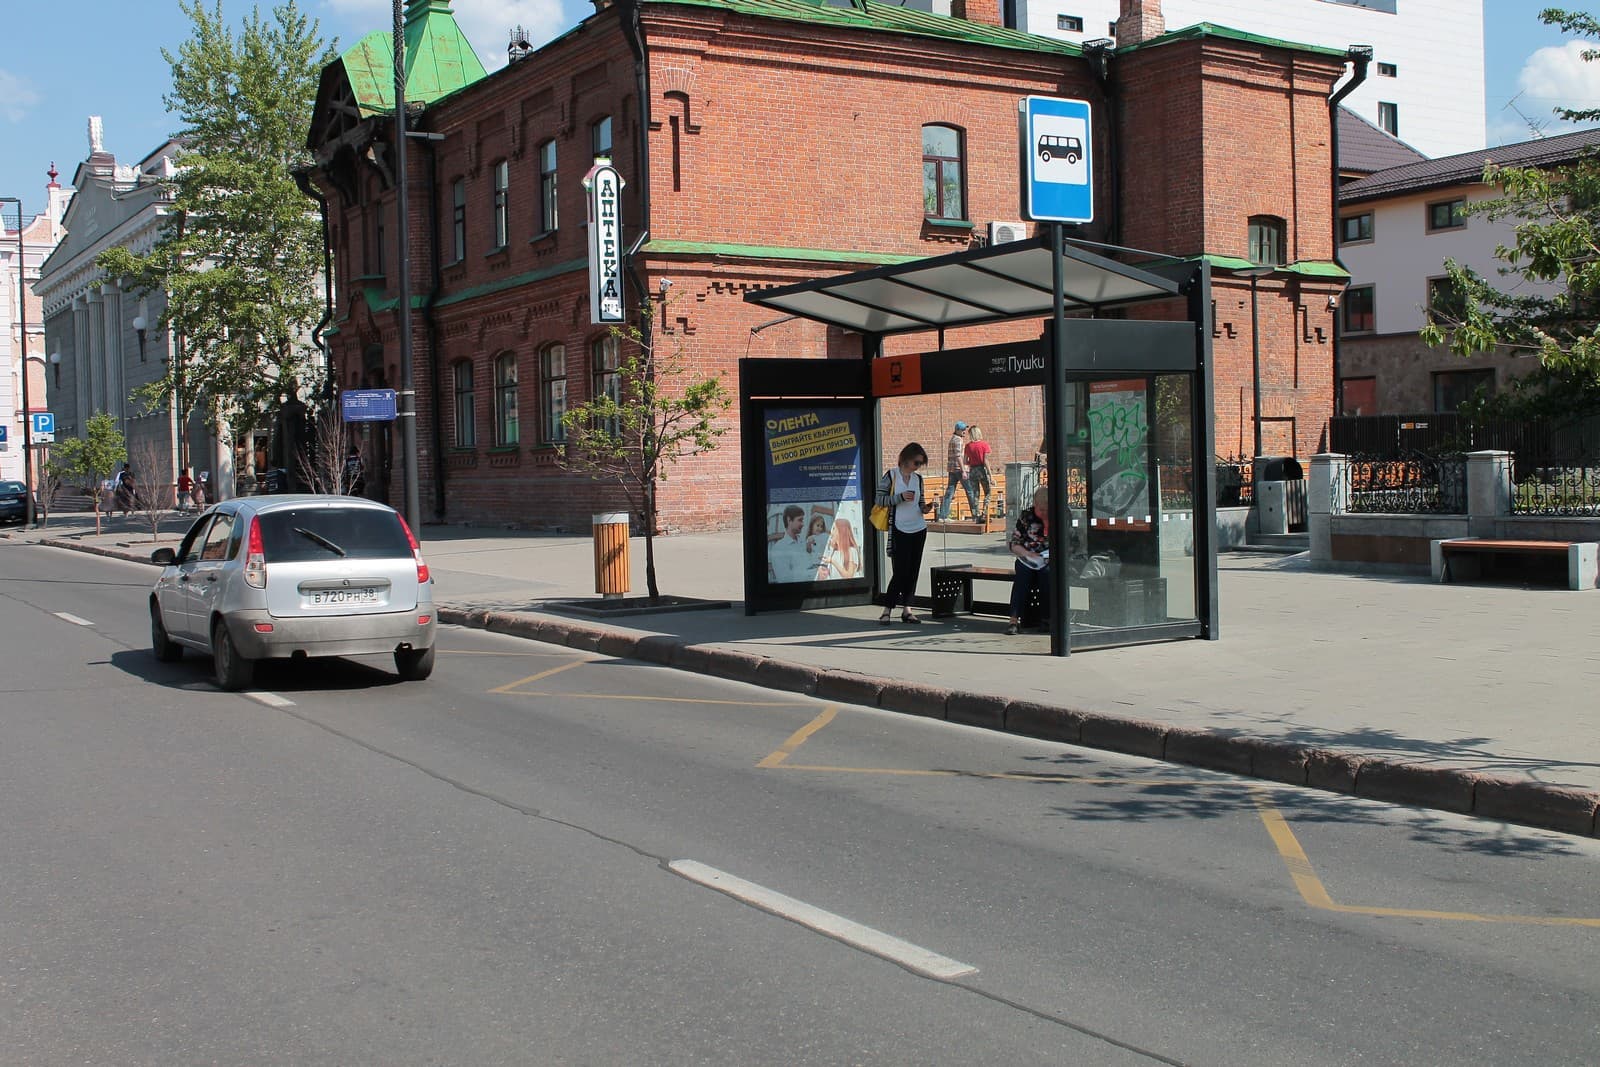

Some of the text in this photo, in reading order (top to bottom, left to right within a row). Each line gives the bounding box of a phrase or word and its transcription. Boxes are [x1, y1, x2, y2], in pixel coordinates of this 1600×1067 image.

[600, 179, 618, 298] АПТЕКА
[38, 415, 50, 431] P
[778, 412, 819, 432] ЛЕНТА
[772, 426, 847, 448] ВЫИГРАЙТЕ КВАРТИРУ
[774, 437, 854, 462] И 1000 ДРУГИХ ПРИЗОВ
